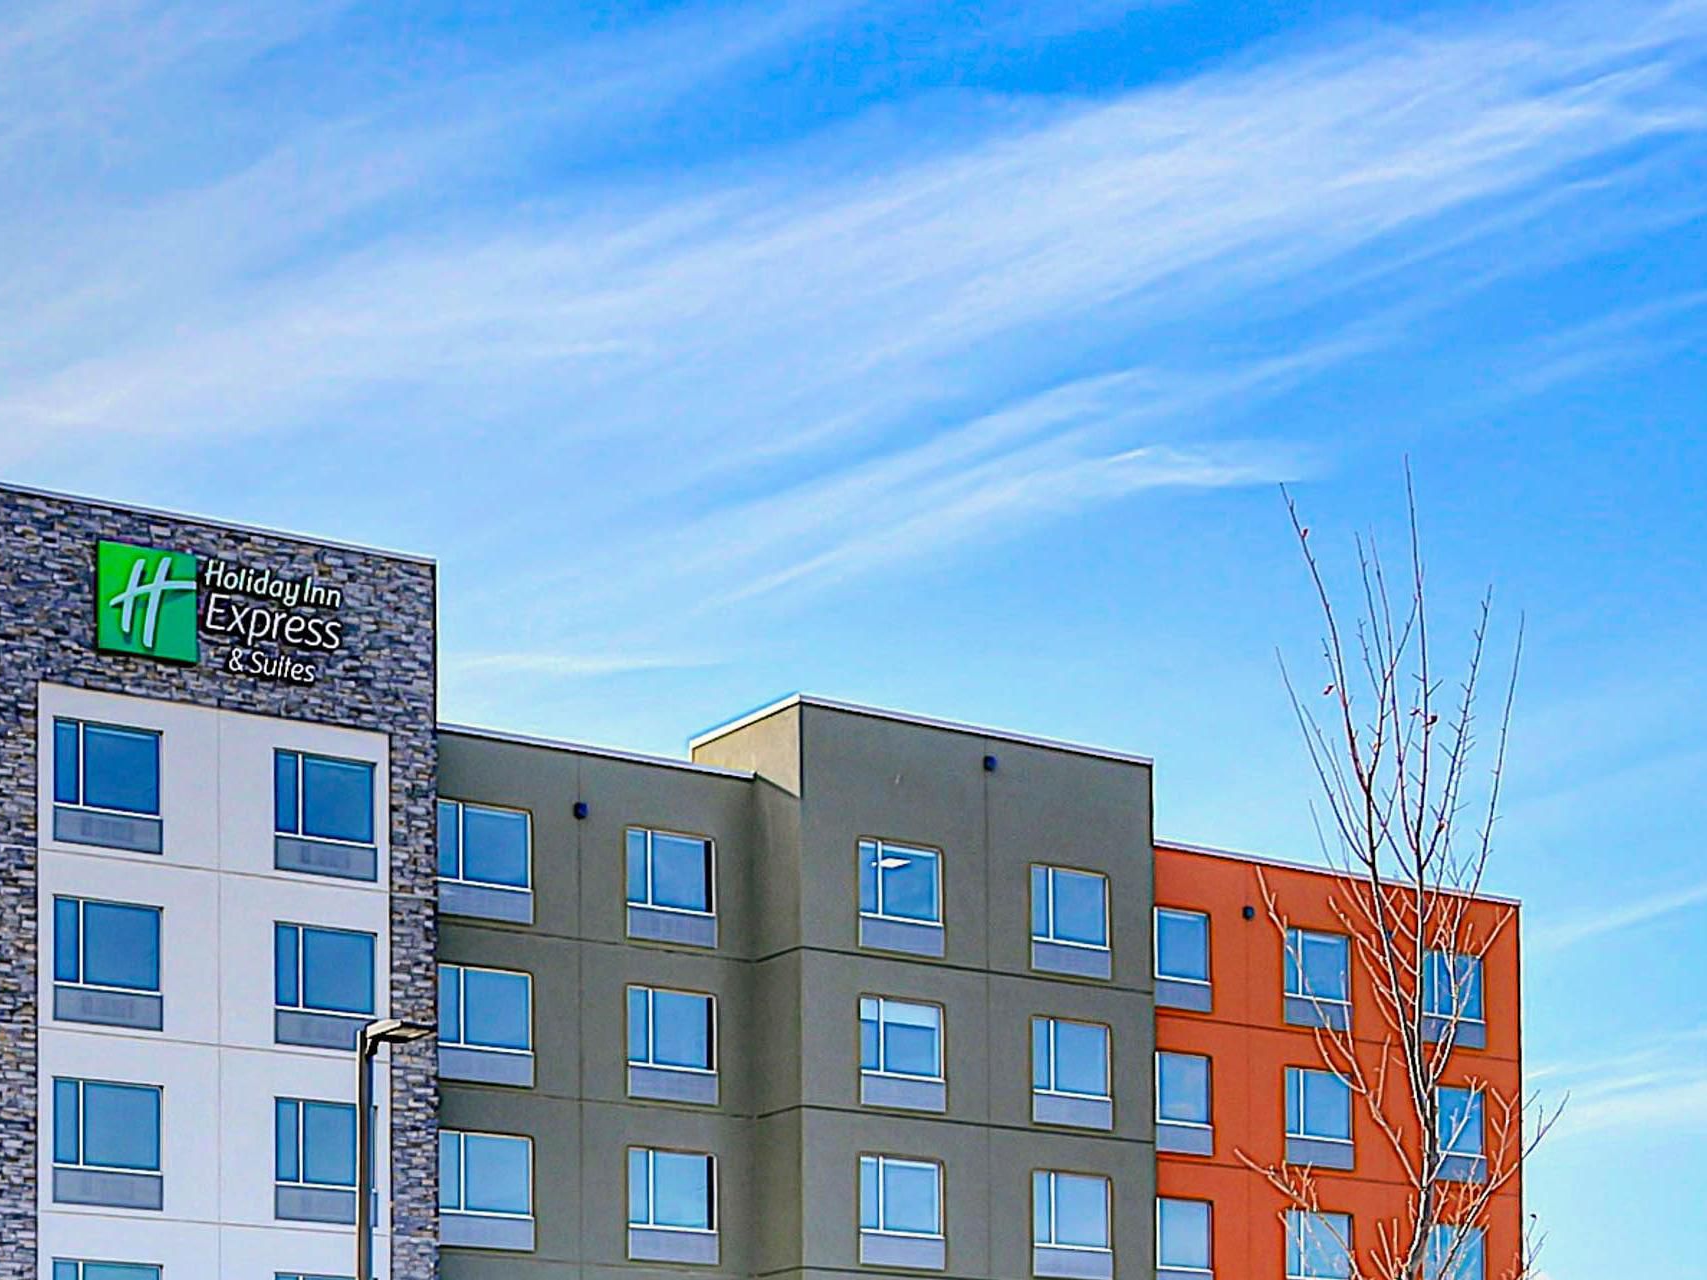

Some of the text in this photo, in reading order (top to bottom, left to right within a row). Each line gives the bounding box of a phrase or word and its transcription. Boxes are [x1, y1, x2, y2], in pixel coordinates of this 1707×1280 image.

[205, 559, 341, 608] Holiday Inn
[205, 593, 342, 650] Express
[228, 648, 316, 682] & Suites
